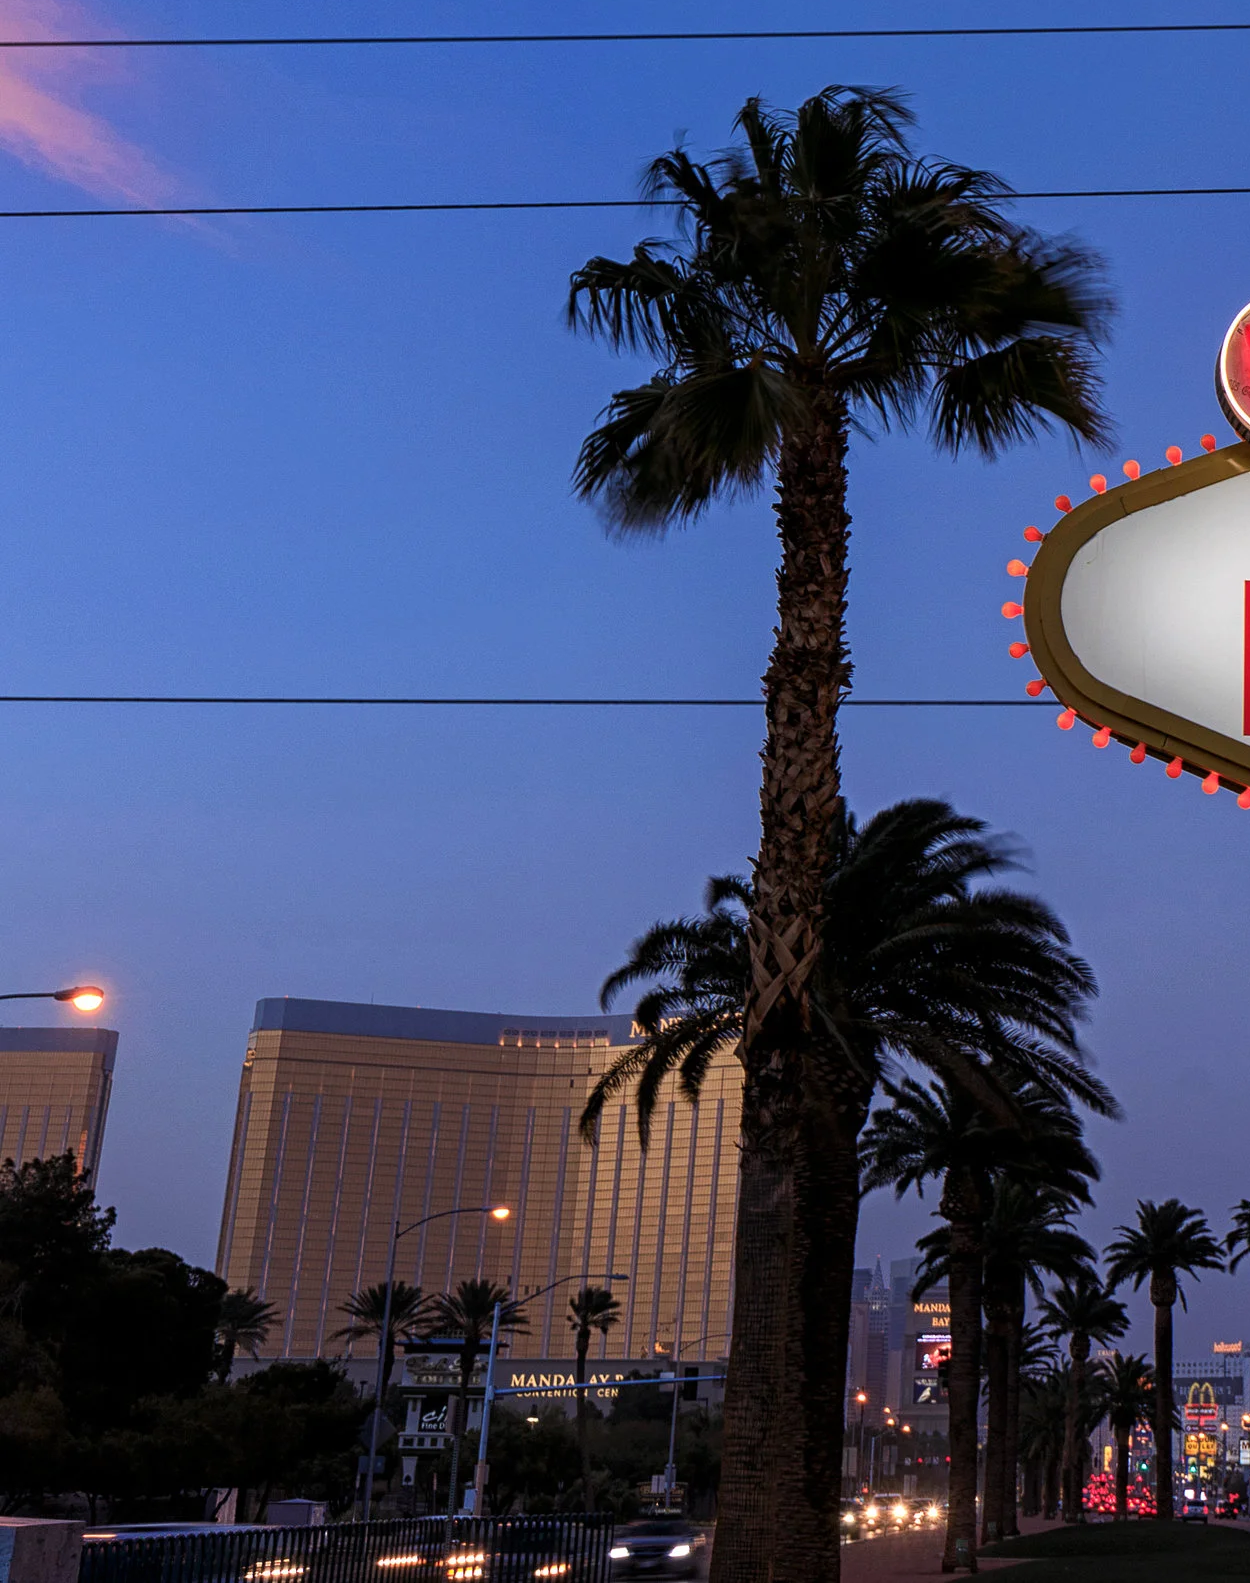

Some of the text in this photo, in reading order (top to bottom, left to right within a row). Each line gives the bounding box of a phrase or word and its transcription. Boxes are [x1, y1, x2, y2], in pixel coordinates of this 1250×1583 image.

[914, 1303, 951, 1313] MANDA
[932, 1317, 951, 1327] BAY
[511, 1373, 610, 1387] MANDAAY
[597, 1388, 619, 1398] CEN
